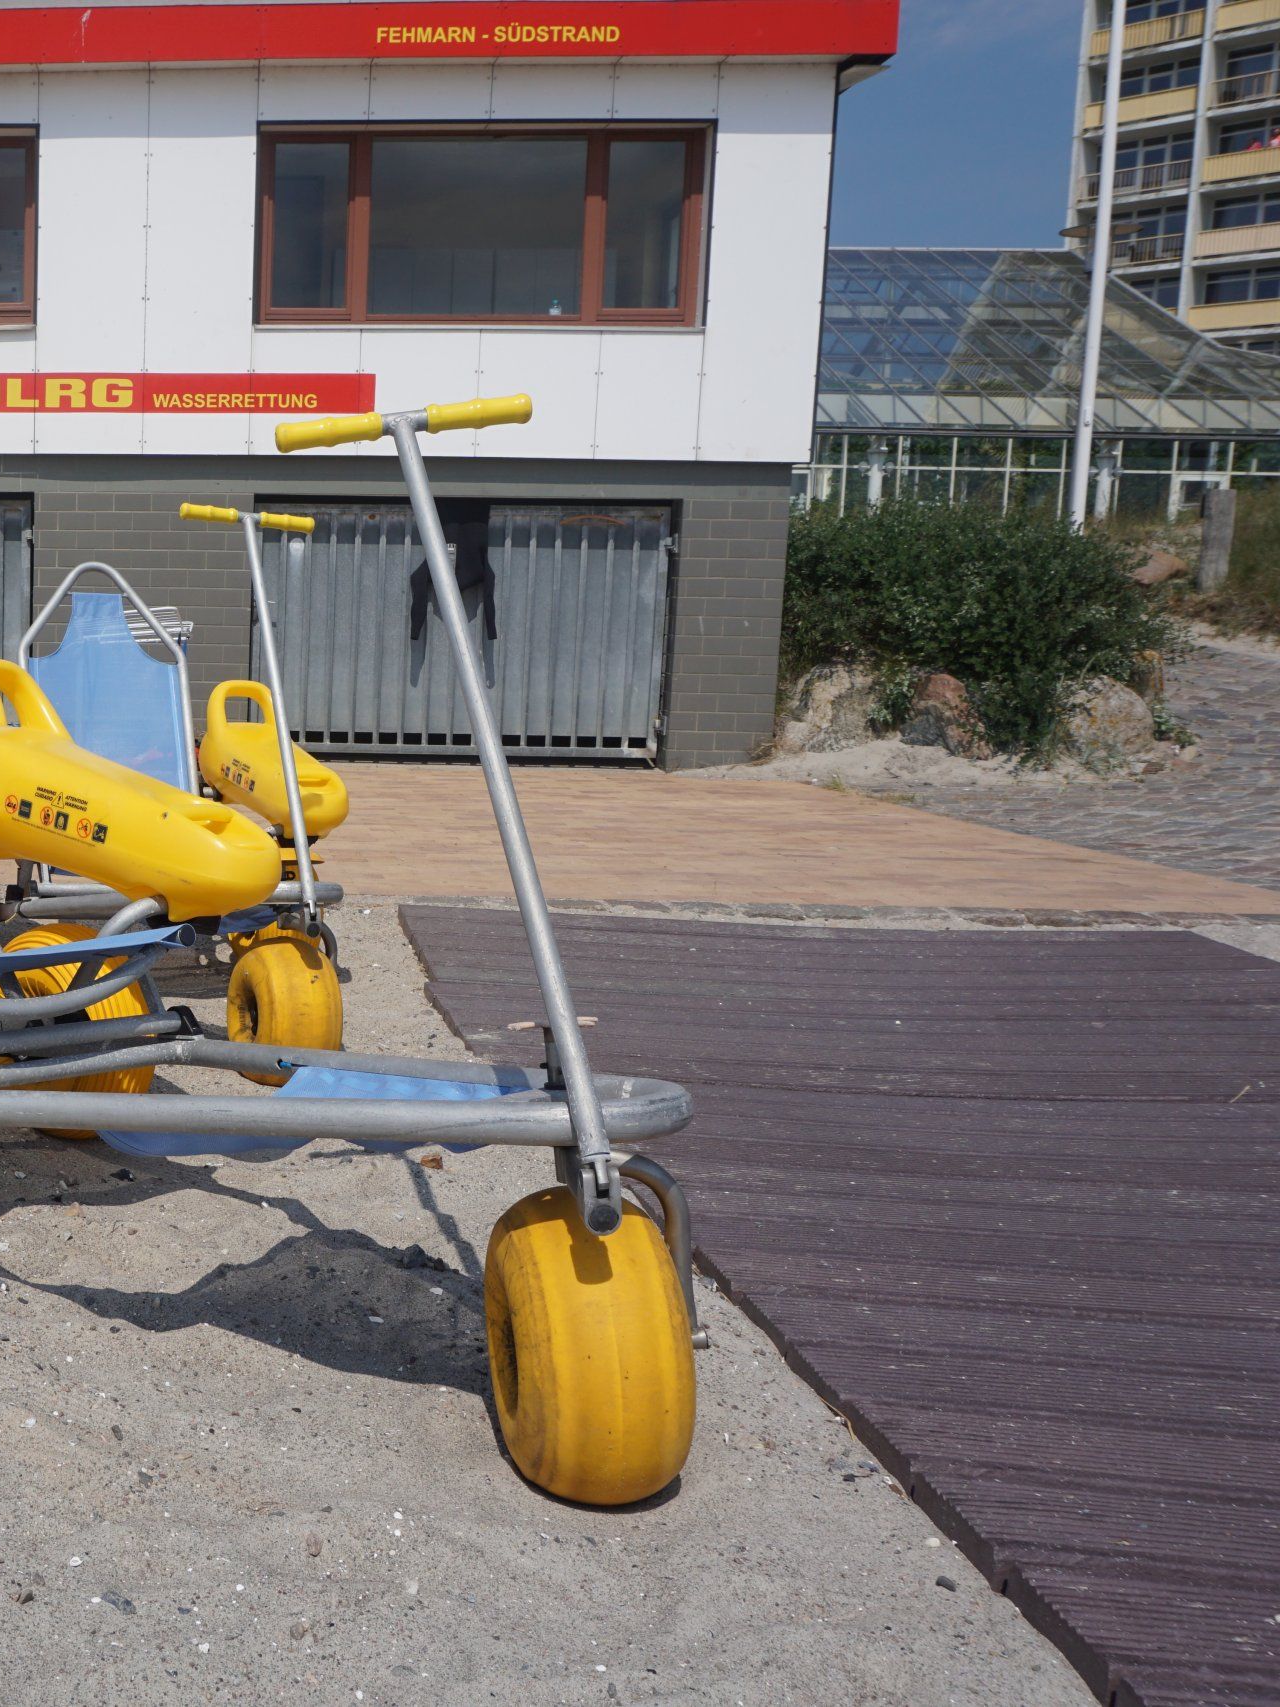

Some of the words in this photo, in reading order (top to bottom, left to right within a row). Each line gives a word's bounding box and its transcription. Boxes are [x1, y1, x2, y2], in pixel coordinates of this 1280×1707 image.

[376, 26, 476, 45] FEHMARN
[493, 22, 621, 44] SÜDSTRAND
[152, 393, 318, 409] WASSERRETTUNG
[36, 786, 57, 796] WARNING
[34, 792, 54, 802] CUIDADO
[65, 795, 89, 806] ATTENTION
